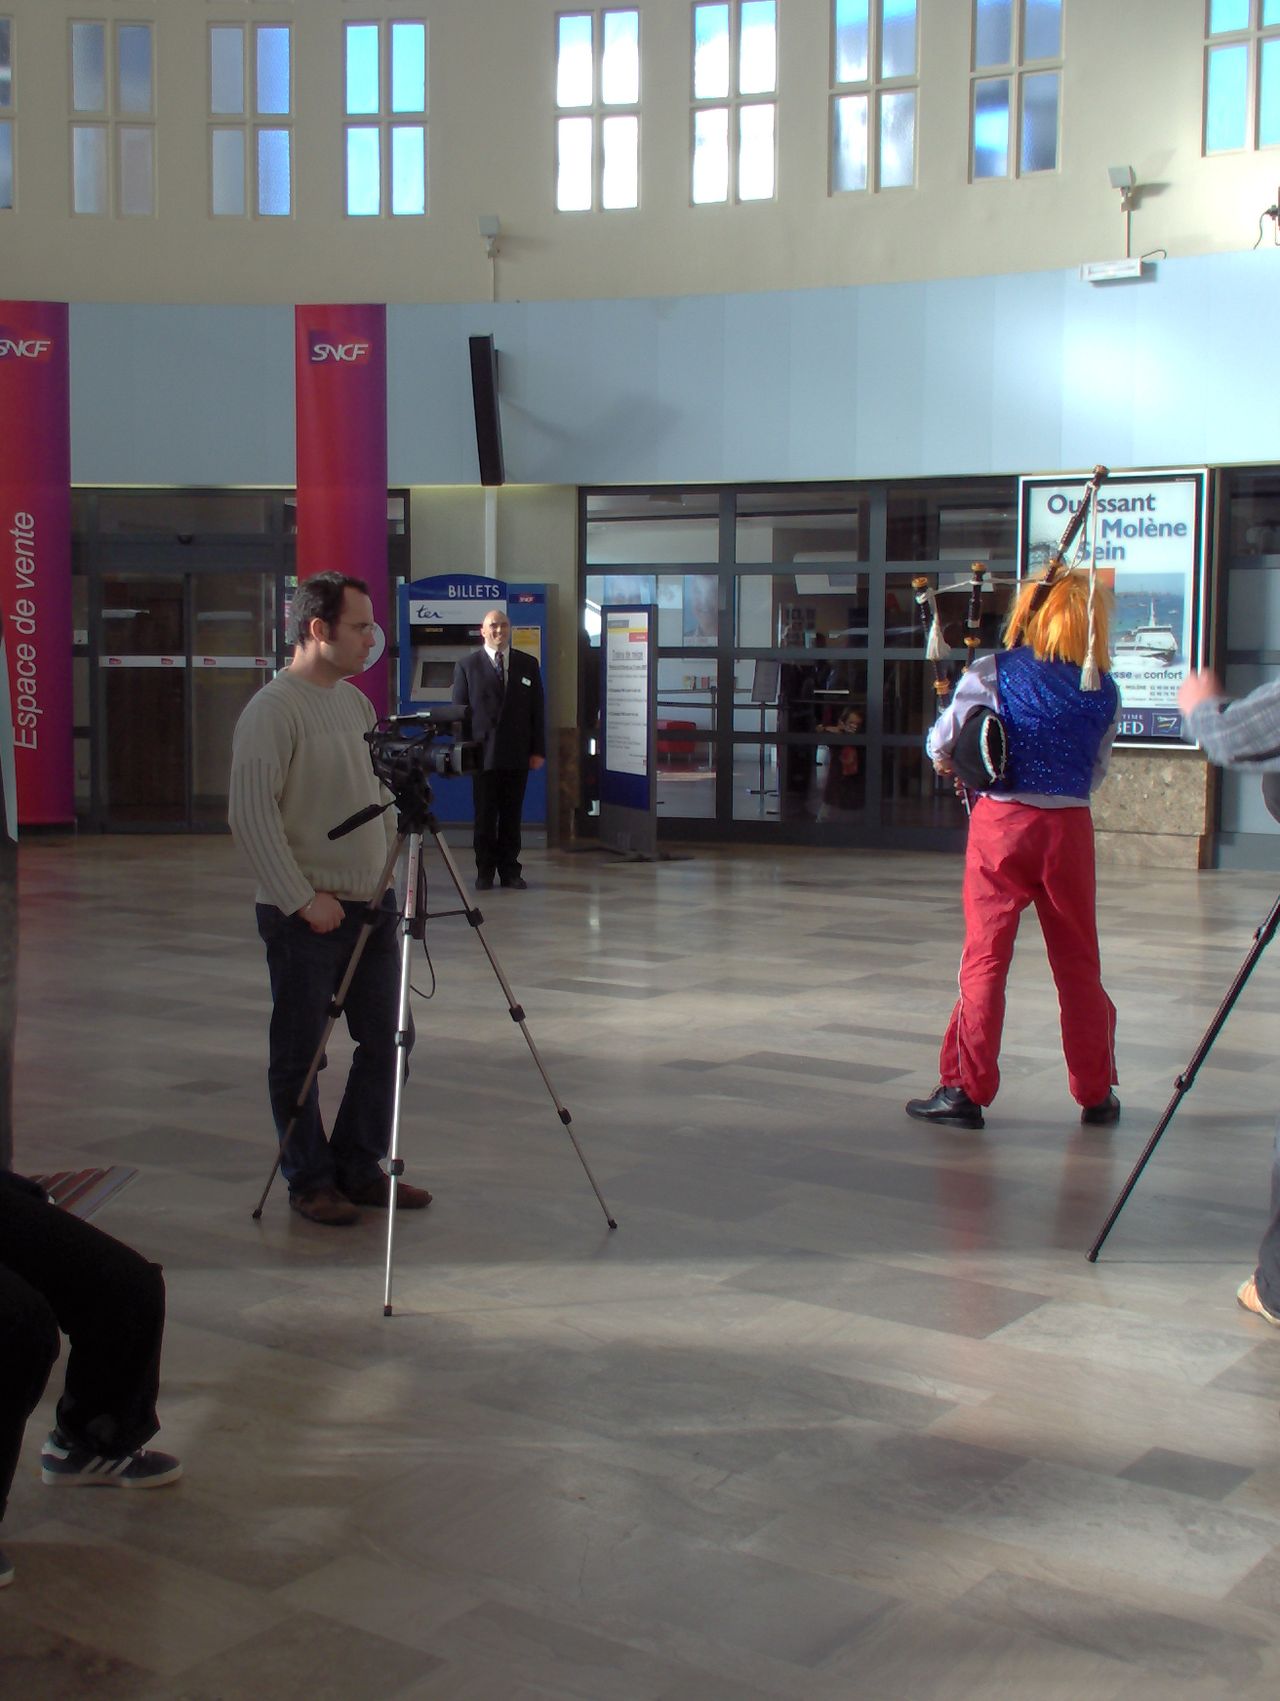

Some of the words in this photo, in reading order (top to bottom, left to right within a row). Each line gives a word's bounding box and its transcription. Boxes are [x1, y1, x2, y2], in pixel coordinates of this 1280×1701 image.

[0, 339, 51, 357] SNCF
[311, 343, 369, 361] SNCF
[1047, 493, 1156, 514] Oussant
[1102, 518, 1187, 538] Molène
[9, 511, 35, 589] vente
[448, 584, 500, 598] BILLETS
[9, 599, 36, 635] de
[416, 604, 443, 619] ter
[1144, 670, 1183, 680] confort
[13, 643, 43, 749] Espace
